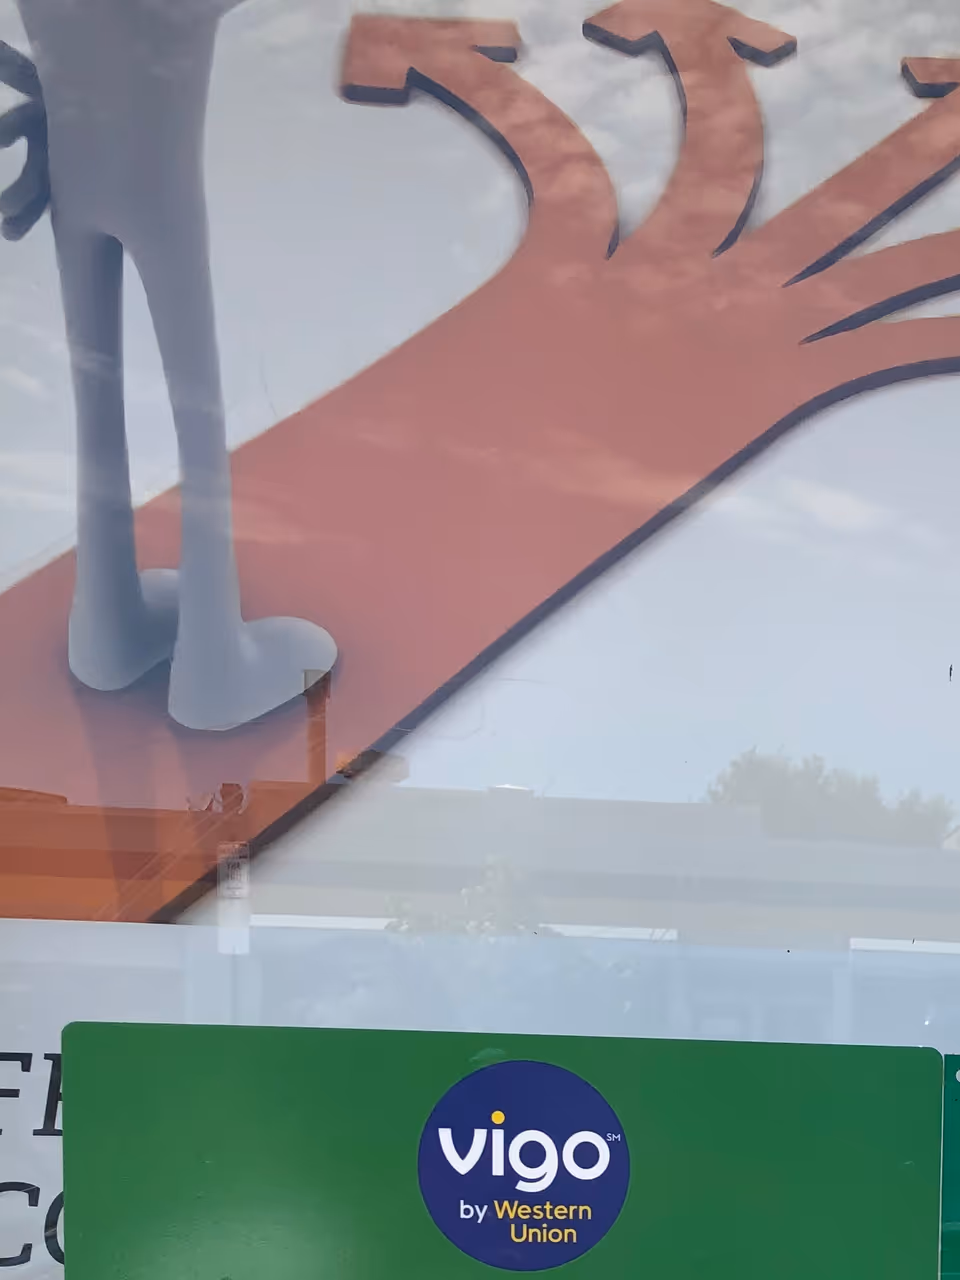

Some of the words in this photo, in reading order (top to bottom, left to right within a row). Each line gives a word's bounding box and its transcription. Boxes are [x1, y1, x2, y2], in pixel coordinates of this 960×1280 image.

[438, 1110, 610, 1193] vigo
[459, 1200, 488, 1223] by
[494, 1200, 592, 1220] Western
[510, 1223, 578, 1244] Union
